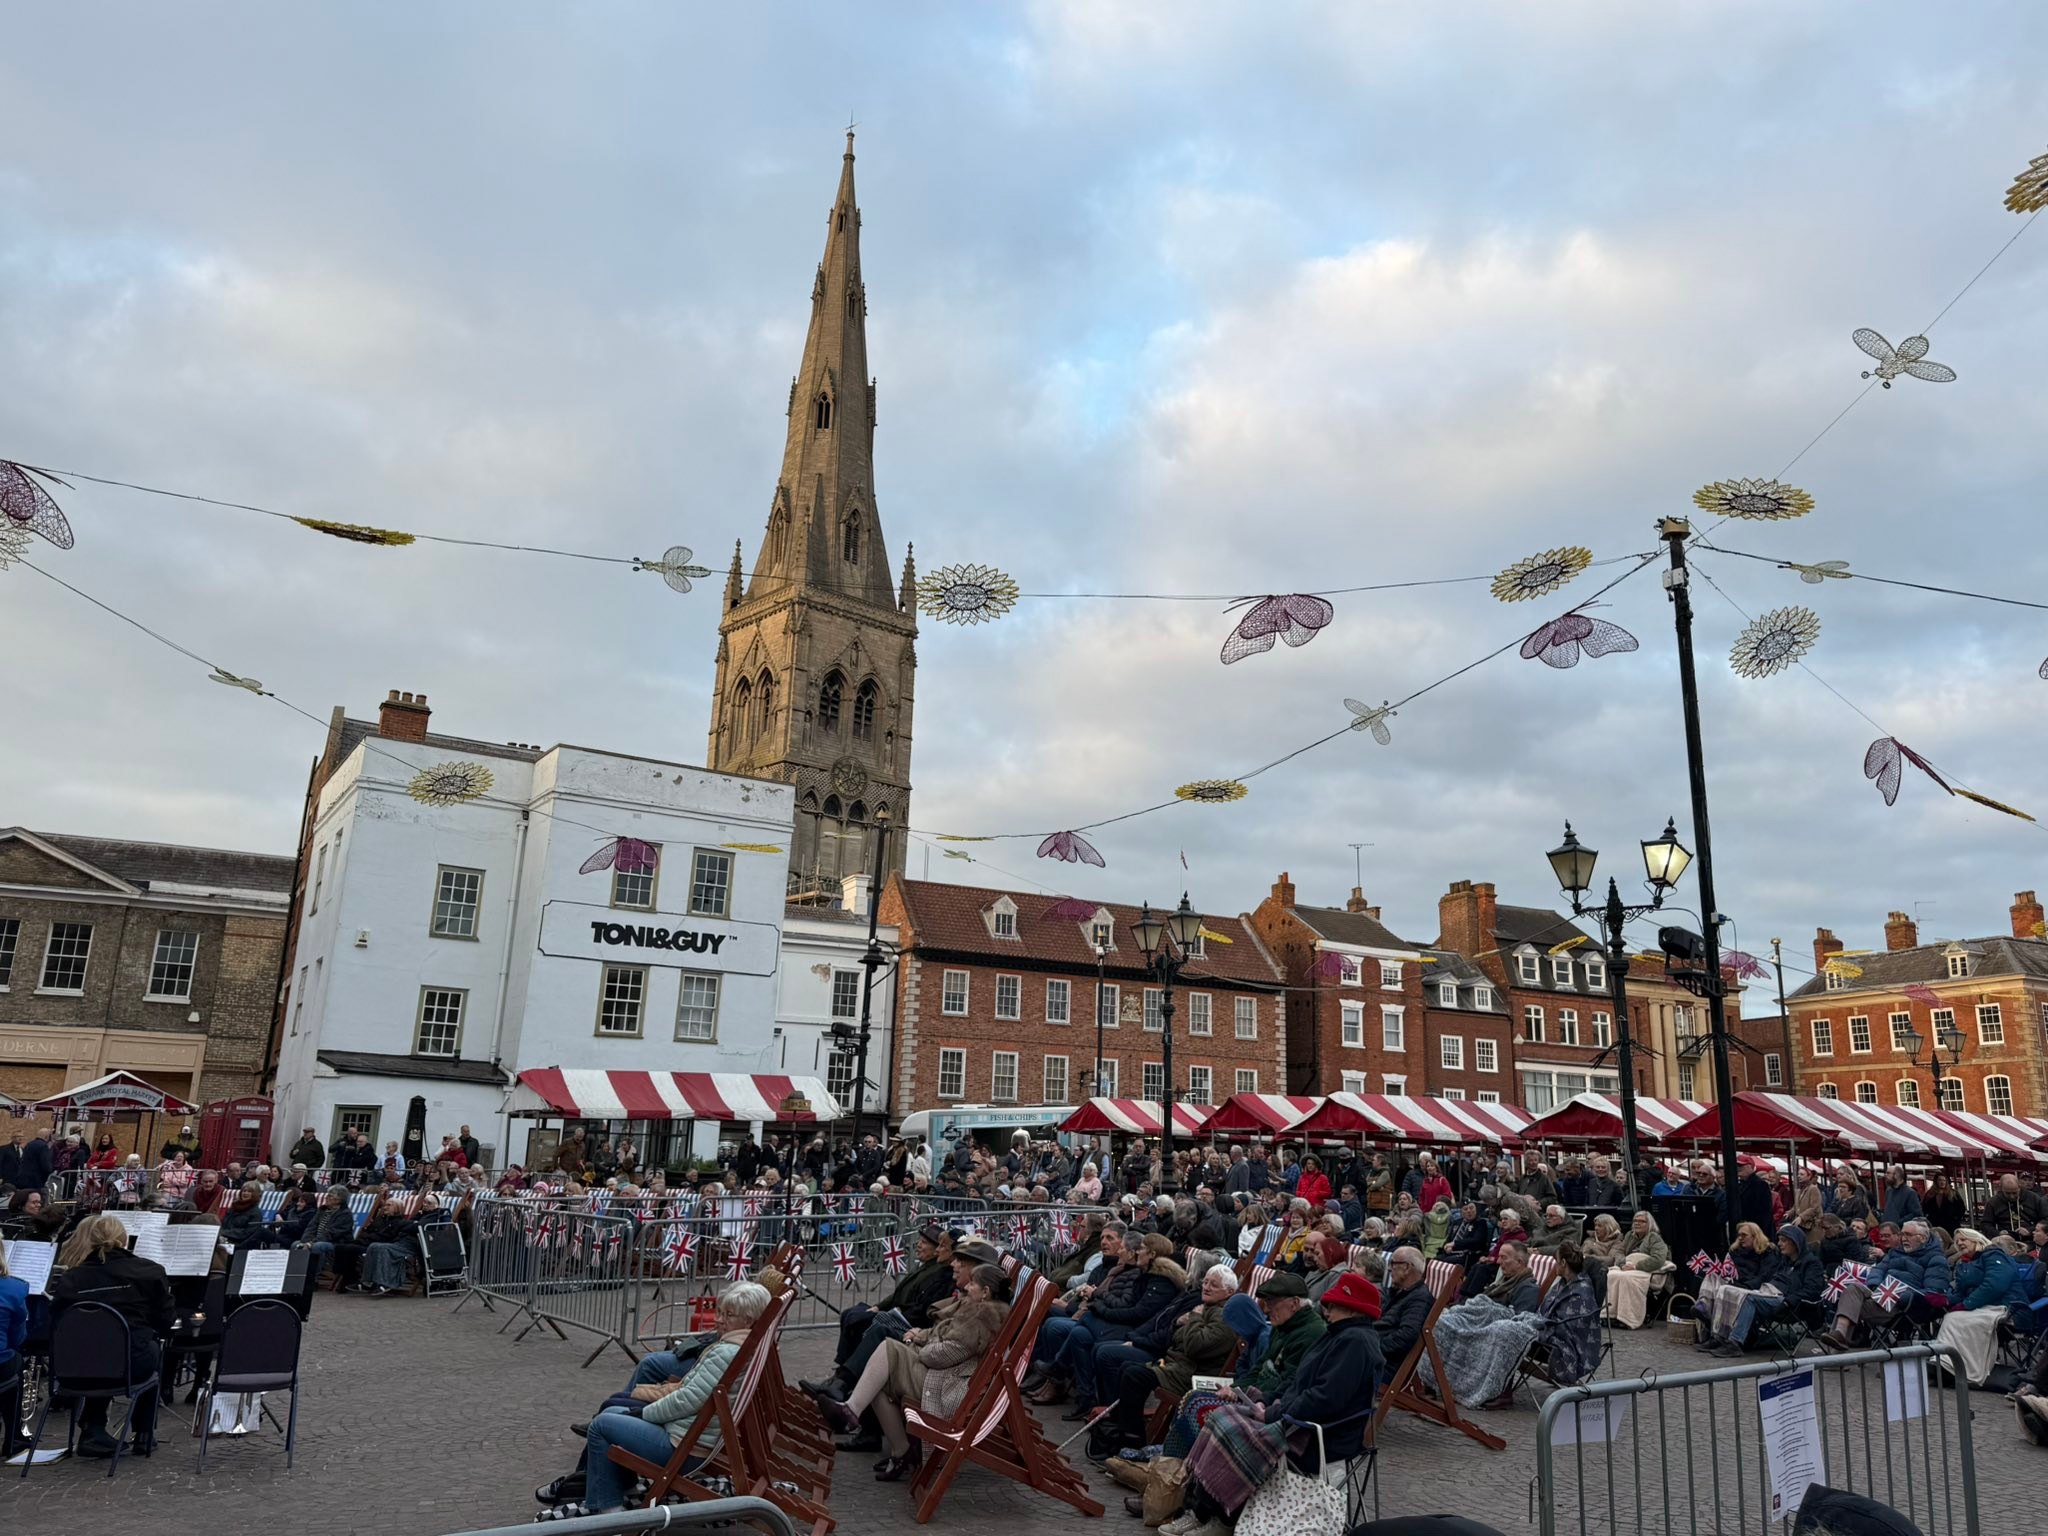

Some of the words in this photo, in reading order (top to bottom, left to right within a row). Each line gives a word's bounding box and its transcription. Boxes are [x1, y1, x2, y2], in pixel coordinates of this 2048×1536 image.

[591, 921, 726, 955] TONI&GUY
[0, 1039, 59, 1054] DERNE
[77, 1087, 106, 1101] NEWARK
[107, 1087, 130, 1095] ROYAL
[131, 1088, 158, 1103] MARKET
[990, 1113, 1007, 1121] FISH
[1015, 1113, 1038, 1121] CHIPS
